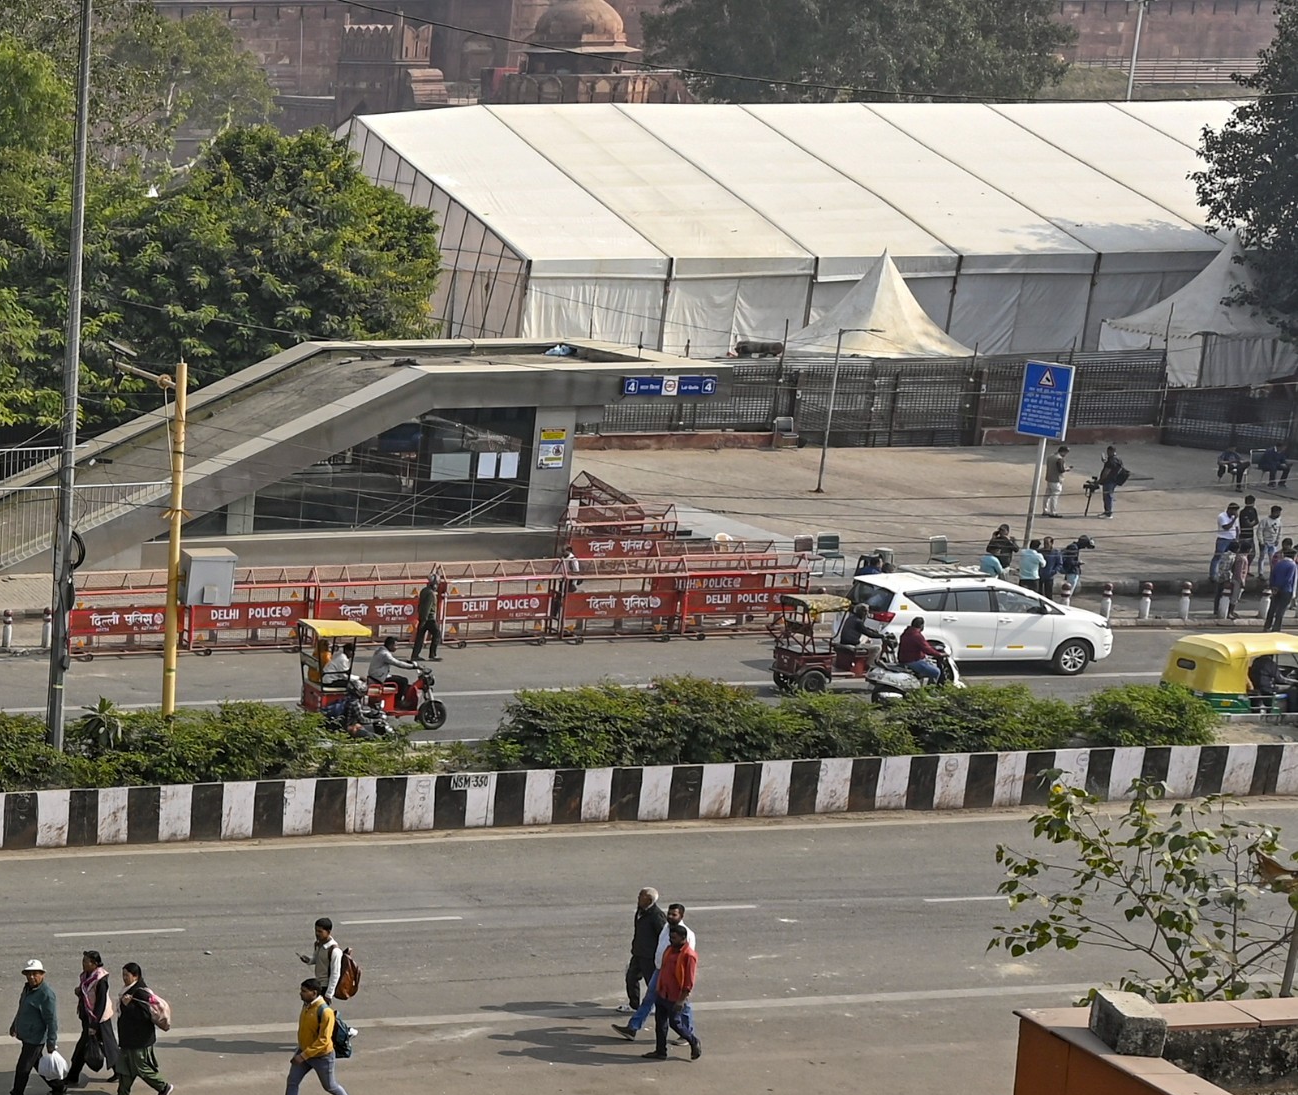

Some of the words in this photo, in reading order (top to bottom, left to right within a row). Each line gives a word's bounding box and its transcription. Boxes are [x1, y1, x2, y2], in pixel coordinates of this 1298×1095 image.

[627, 382, 636, 391] 4
[704, 382, 712, 391] 4
[703, 577, 734, 588] POLICE
[586, 595, 617, 610] दिल्ली
[706, 594, 731, 604] DELHI
[737, 593, 769, 603] POLICE
[339, 603, 369, 617] दिल्ली
[375, 603, 404, 617] पुलिस
[462, 601, 488, 612] DELHI
[497, 599, 529, 610] POLICE
[89, 611, 120, 627] दिल्ली
[123, 611, 153, 627] पुलिस
[211, 609, 239, 620] DELHI
[248, 606, 282, 619] POLICE
[452, 775, 488, 789] NSM-350
